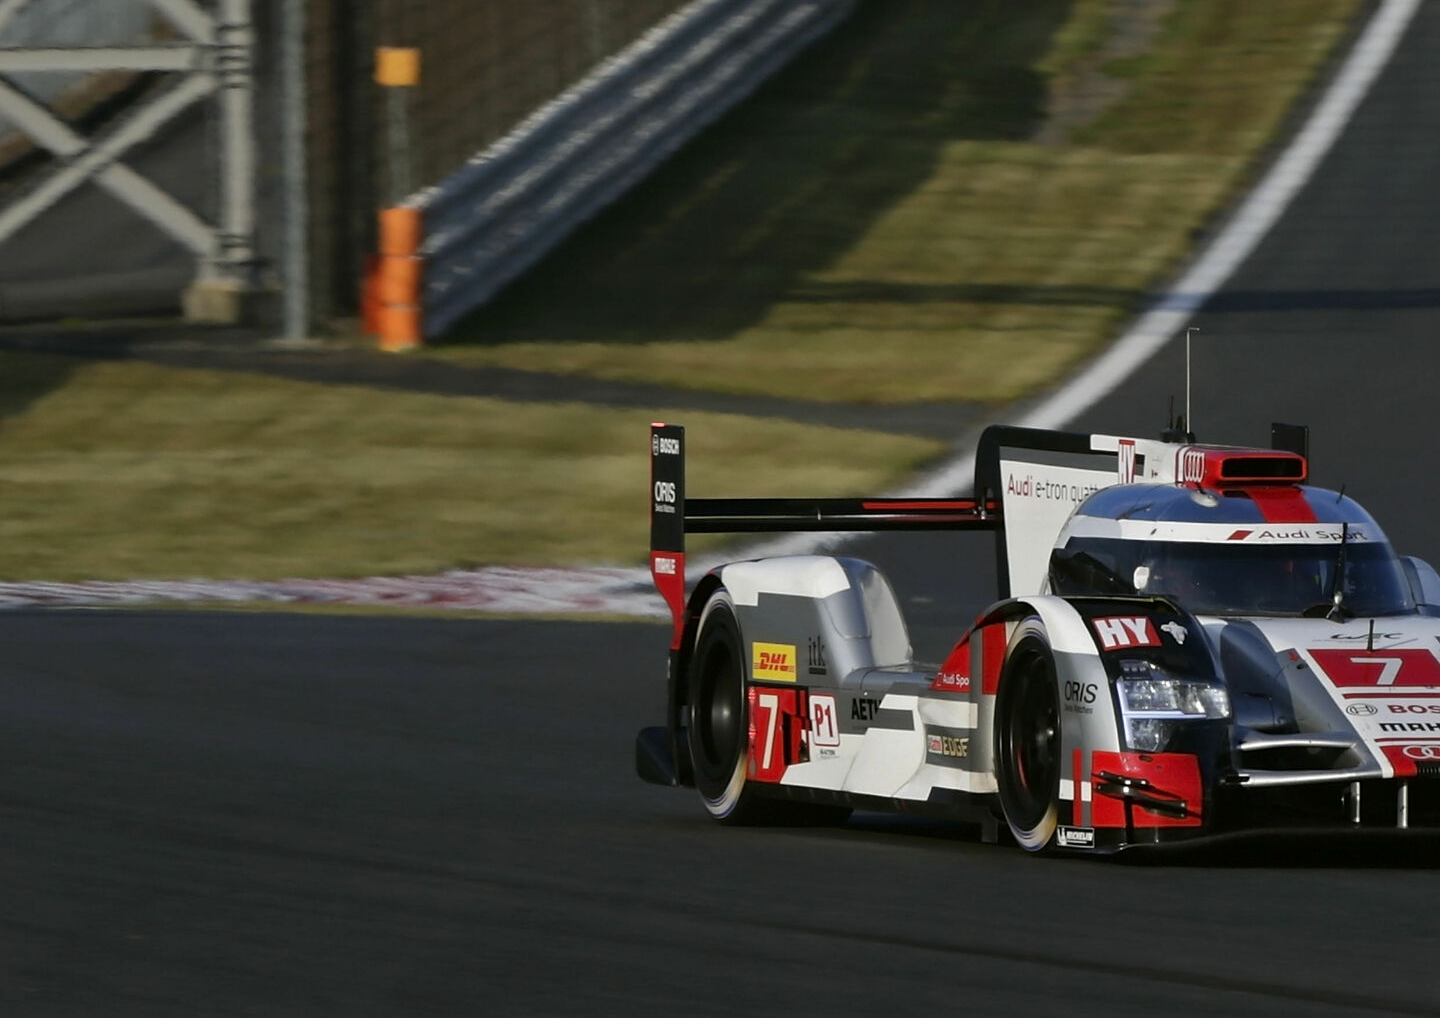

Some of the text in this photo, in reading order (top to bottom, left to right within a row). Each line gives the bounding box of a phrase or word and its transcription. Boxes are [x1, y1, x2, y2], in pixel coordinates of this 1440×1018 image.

[659, 438, 680, 455] BOSCH
[1118, 445, 1135, 484] HY
[654, 481, 676, 503] ORIS
[1007, 473, 1033, 497] Audi
[1036, 480, 1069, 500] e-tron
[1258, 529, 1368, 541] Audi Sport
[1094, 618, 1150, 648] HY
[759, 652, 789, 672] DHL
[1350, 657, 1403, 686] 7
[943, 673, 955, 684] Audi
[1064, 680, 1098, 703] ORIS
[759, 694, 779, 769] 7
[813, 703, 835, 738] P1
[942, 736, 969, 757] EDGE
